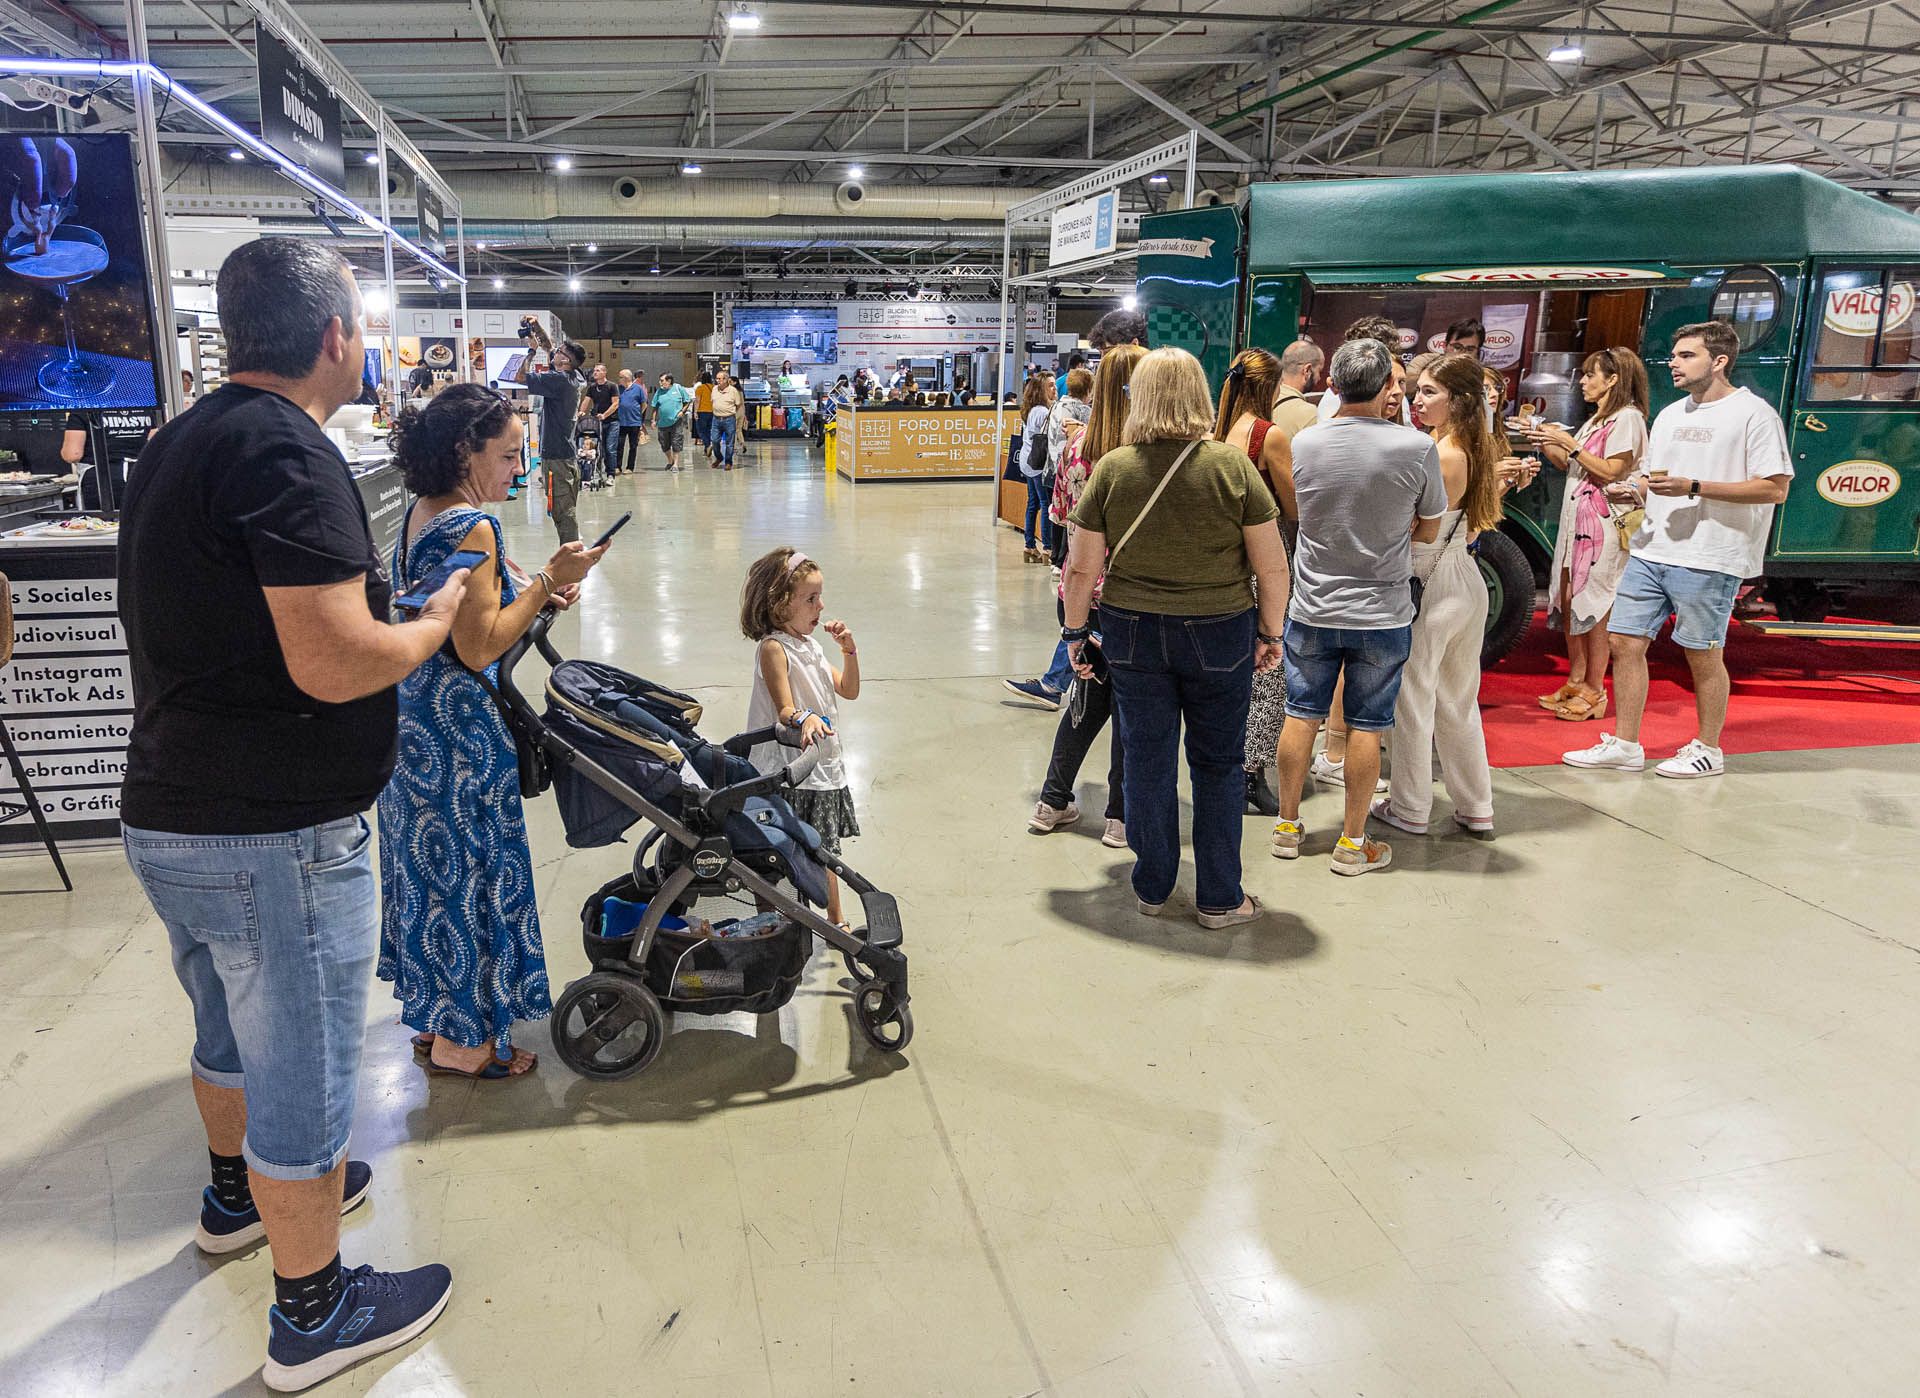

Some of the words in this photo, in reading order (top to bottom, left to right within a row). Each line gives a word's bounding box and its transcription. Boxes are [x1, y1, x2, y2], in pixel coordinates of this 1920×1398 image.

[1058, 219, 1079, 233] TURRONES
[1057, 237, 1063, 247] DE
[1831, 293, 1901, 315] VALOR
[898, 419, 940, 431] FORO
[944, 418, 973, 431] DEL
[977, 418, 1007, 431] PAN
[904, 434, 914, 445] Y
[918, 434, 947, 445] DEL
[951, 433, 998, 445] DULCE
[1826, 476, 1891, 493] VALOR
[28, 585, 113, 603] Sociales
[14, 624, 117, 643] udiovisual
[13, 666, 122, 683] Instagram
[12, 686, 80, 704] TikTok
[87, 685, 125, 701] Ads
[10, 724, 128, 741] ionamiento
[25, 759, 128, 777] ebranding
[61, 795, 121, 812] Gráfic
